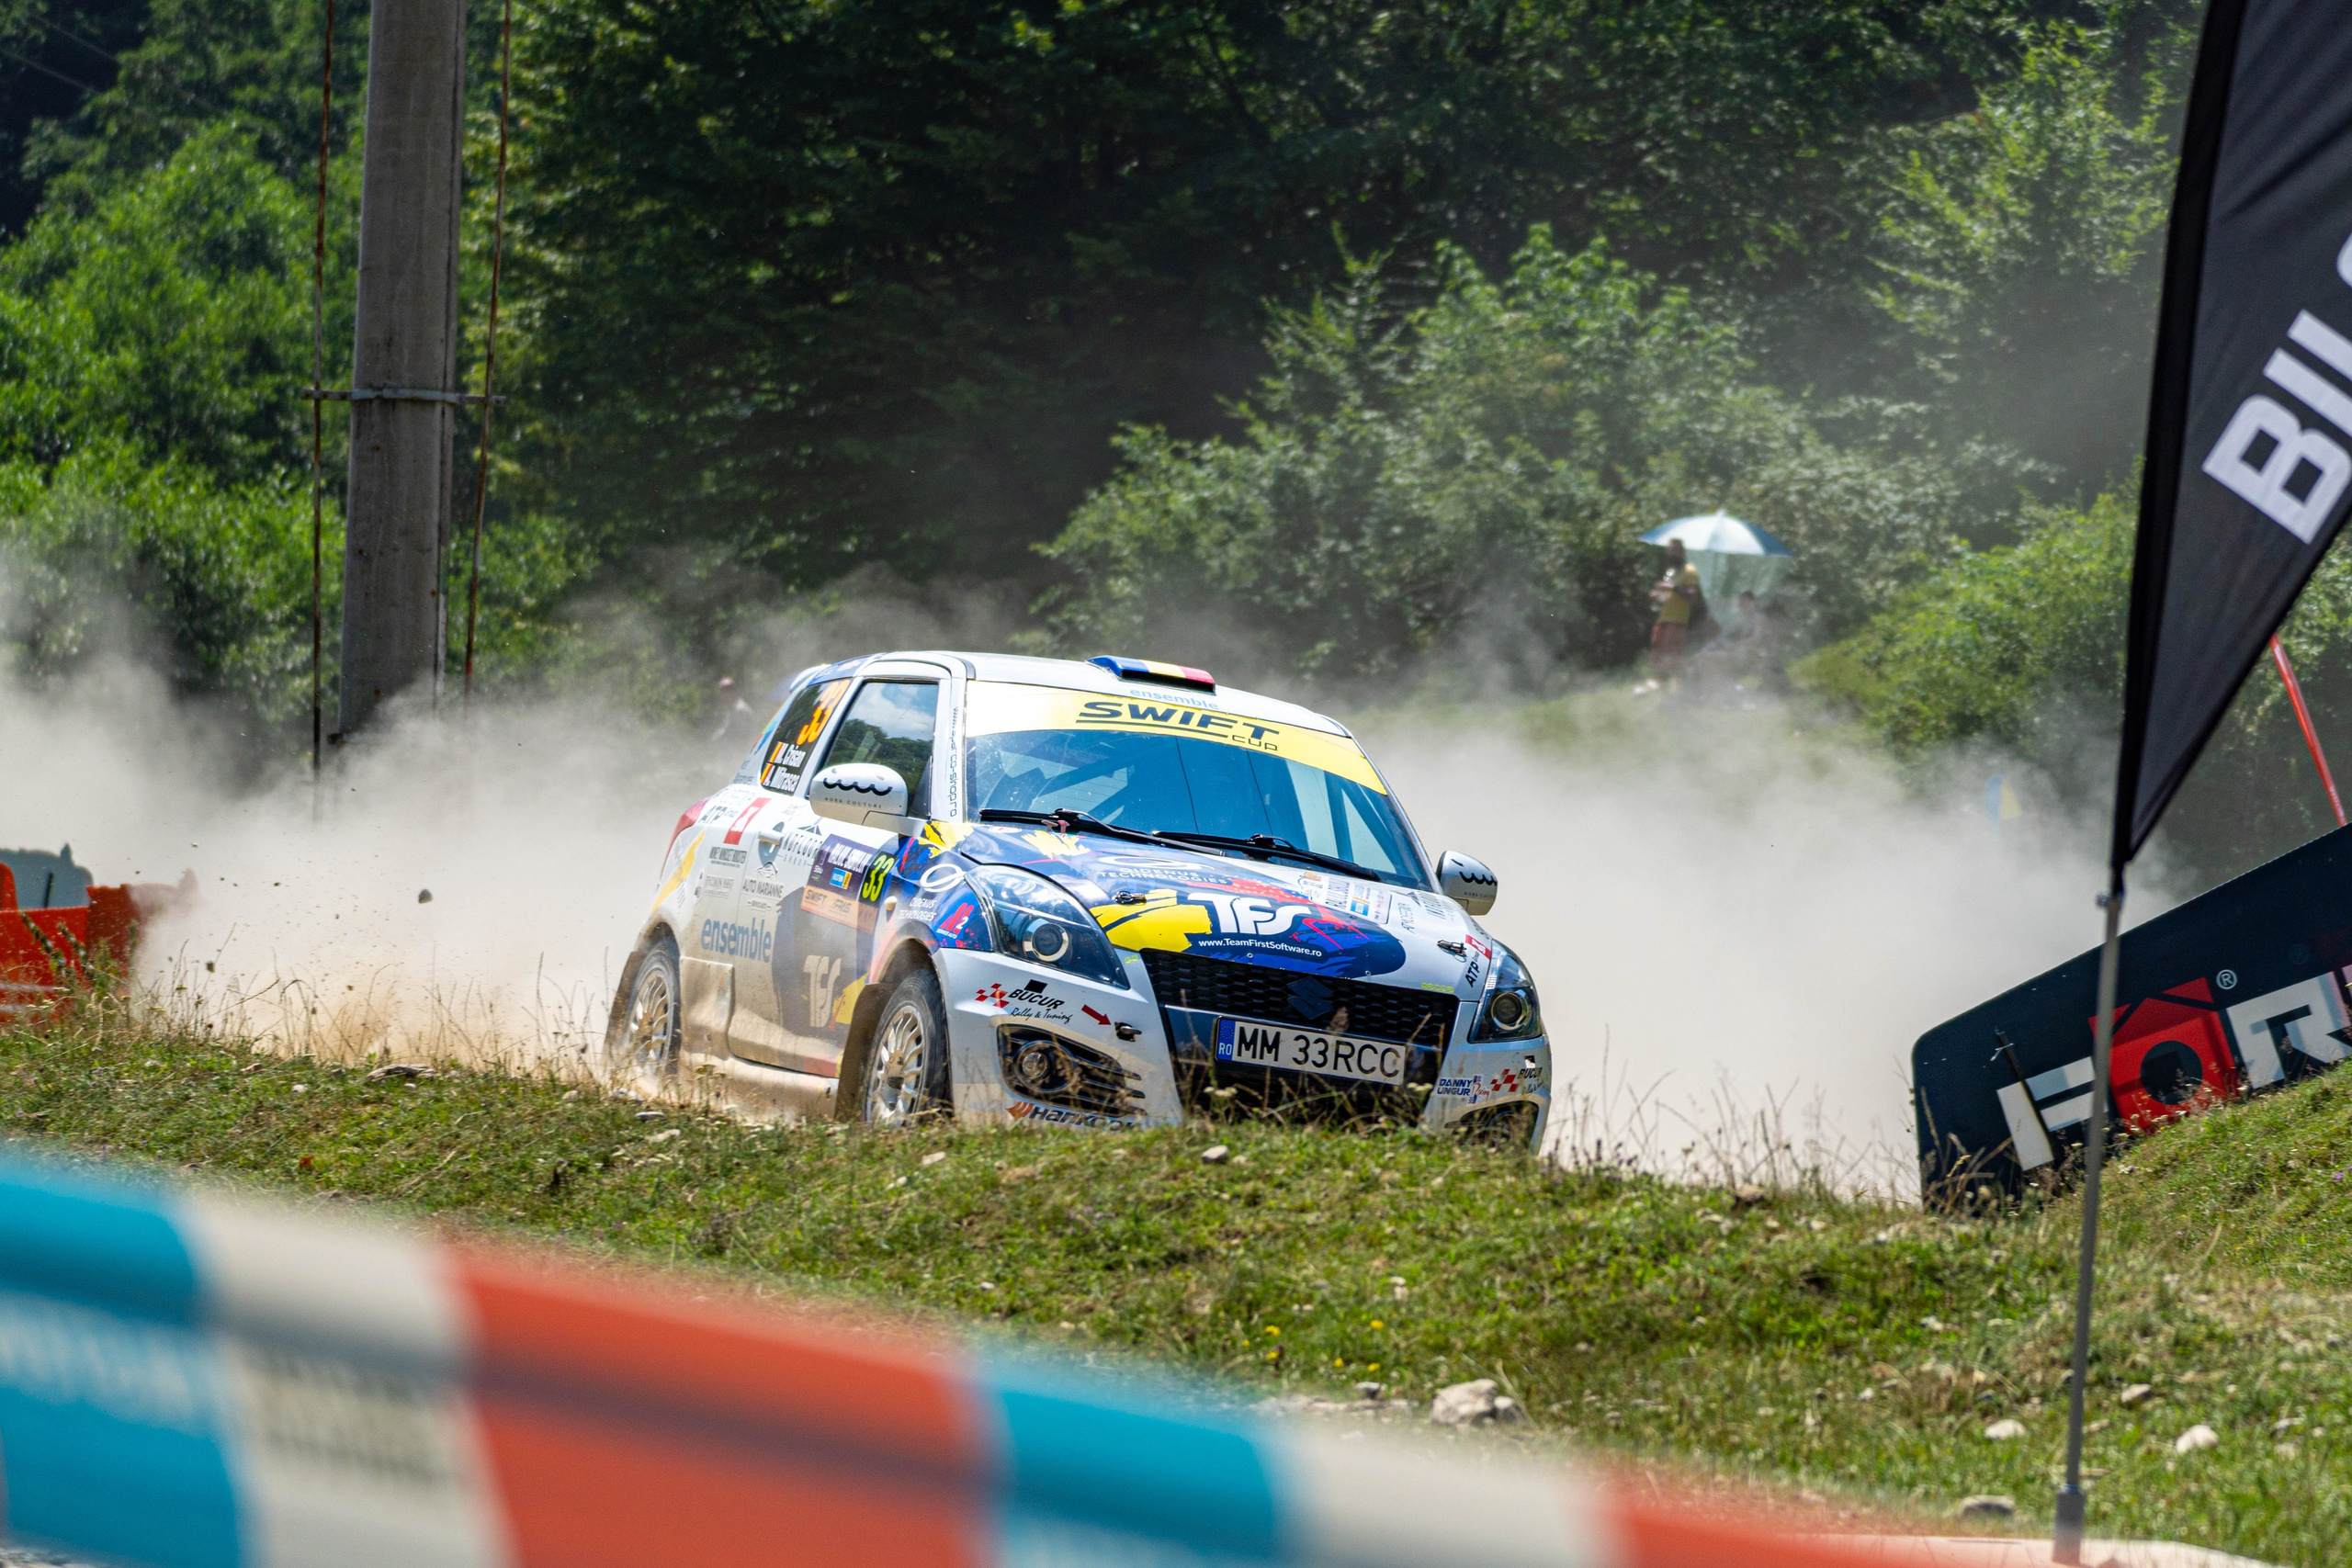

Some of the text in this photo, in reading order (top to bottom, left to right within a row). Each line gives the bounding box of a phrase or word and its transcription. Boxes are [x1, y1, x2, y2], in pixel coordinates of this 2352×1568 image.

[1129, 689, 1218, 709] ensemble
[797, 678, 851, 746] 33
[1079, 701, 1280, 740] SWIFT
[1232, 735, 1278, 751] CUP
[847, 800, 882, 809] COUTURE
[698, 806, 727, 824] ATP
[862, 854, 895, 902] 33
[1100, 872, 1228, 884] TECHNOLOGIES
[806, 889, 828, 905] SWIFT
[899, 909, 937, 921] TECHNOLOGIES
[1188, 892, 1312, 935] TFS
[700, 918, 772, 963] ensemble
[1198, 938, 1322, 957] www.TeamFirstSoftware.ro
[1465, 961, 1479, 988] ATP
[804, 954, 842, 1027] TFS
[1008, 988, 1065, 1010] BUCUR
[1010, 1007, 1032, 1021] Rally
[1043, 1009, 1073, 1024] Tuning
[1219, 1043, 1232, 1055] RO
[1237, 1026, 1281, 1062] MM
[1996, 964, 2352, 1171] FOR
[1437, 1087, 1470, 1096] UNGUR
[1439, 1078, 1472, 1087] DANNY
